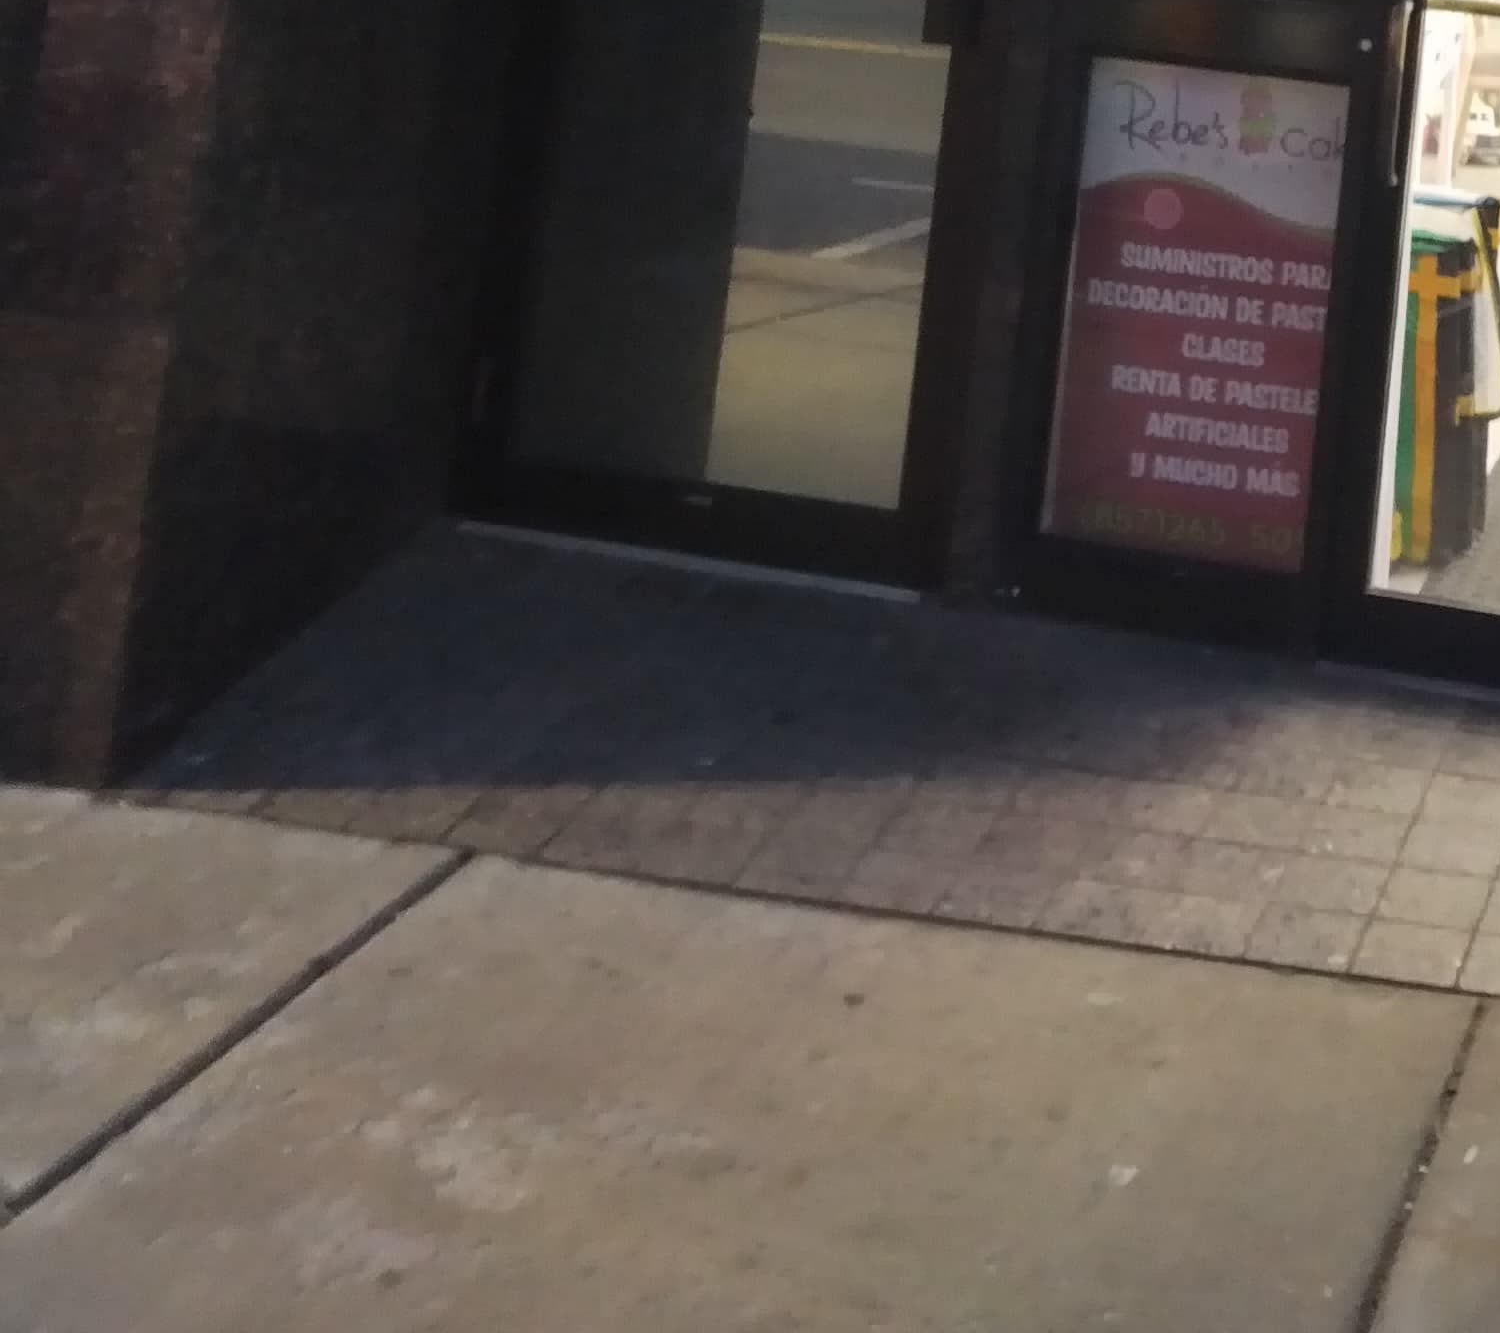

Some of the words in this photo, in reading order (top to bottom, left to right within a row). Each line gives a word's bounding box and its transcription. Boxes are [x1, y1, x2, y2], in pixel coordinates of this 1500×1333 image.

[1120, 242, 1273, 285] SUMINISTROS
[1236, 296, 1264, 325] DE
[1181, 333, 1265, 368] CLASES
[1112, 364, 1181, 398] RENTA
[1189, 375, 1217, 403] DE
[1145, 412, 1289, 455] ARTIFICIALES
[1153, 455, 1237, 491] MUCHO
